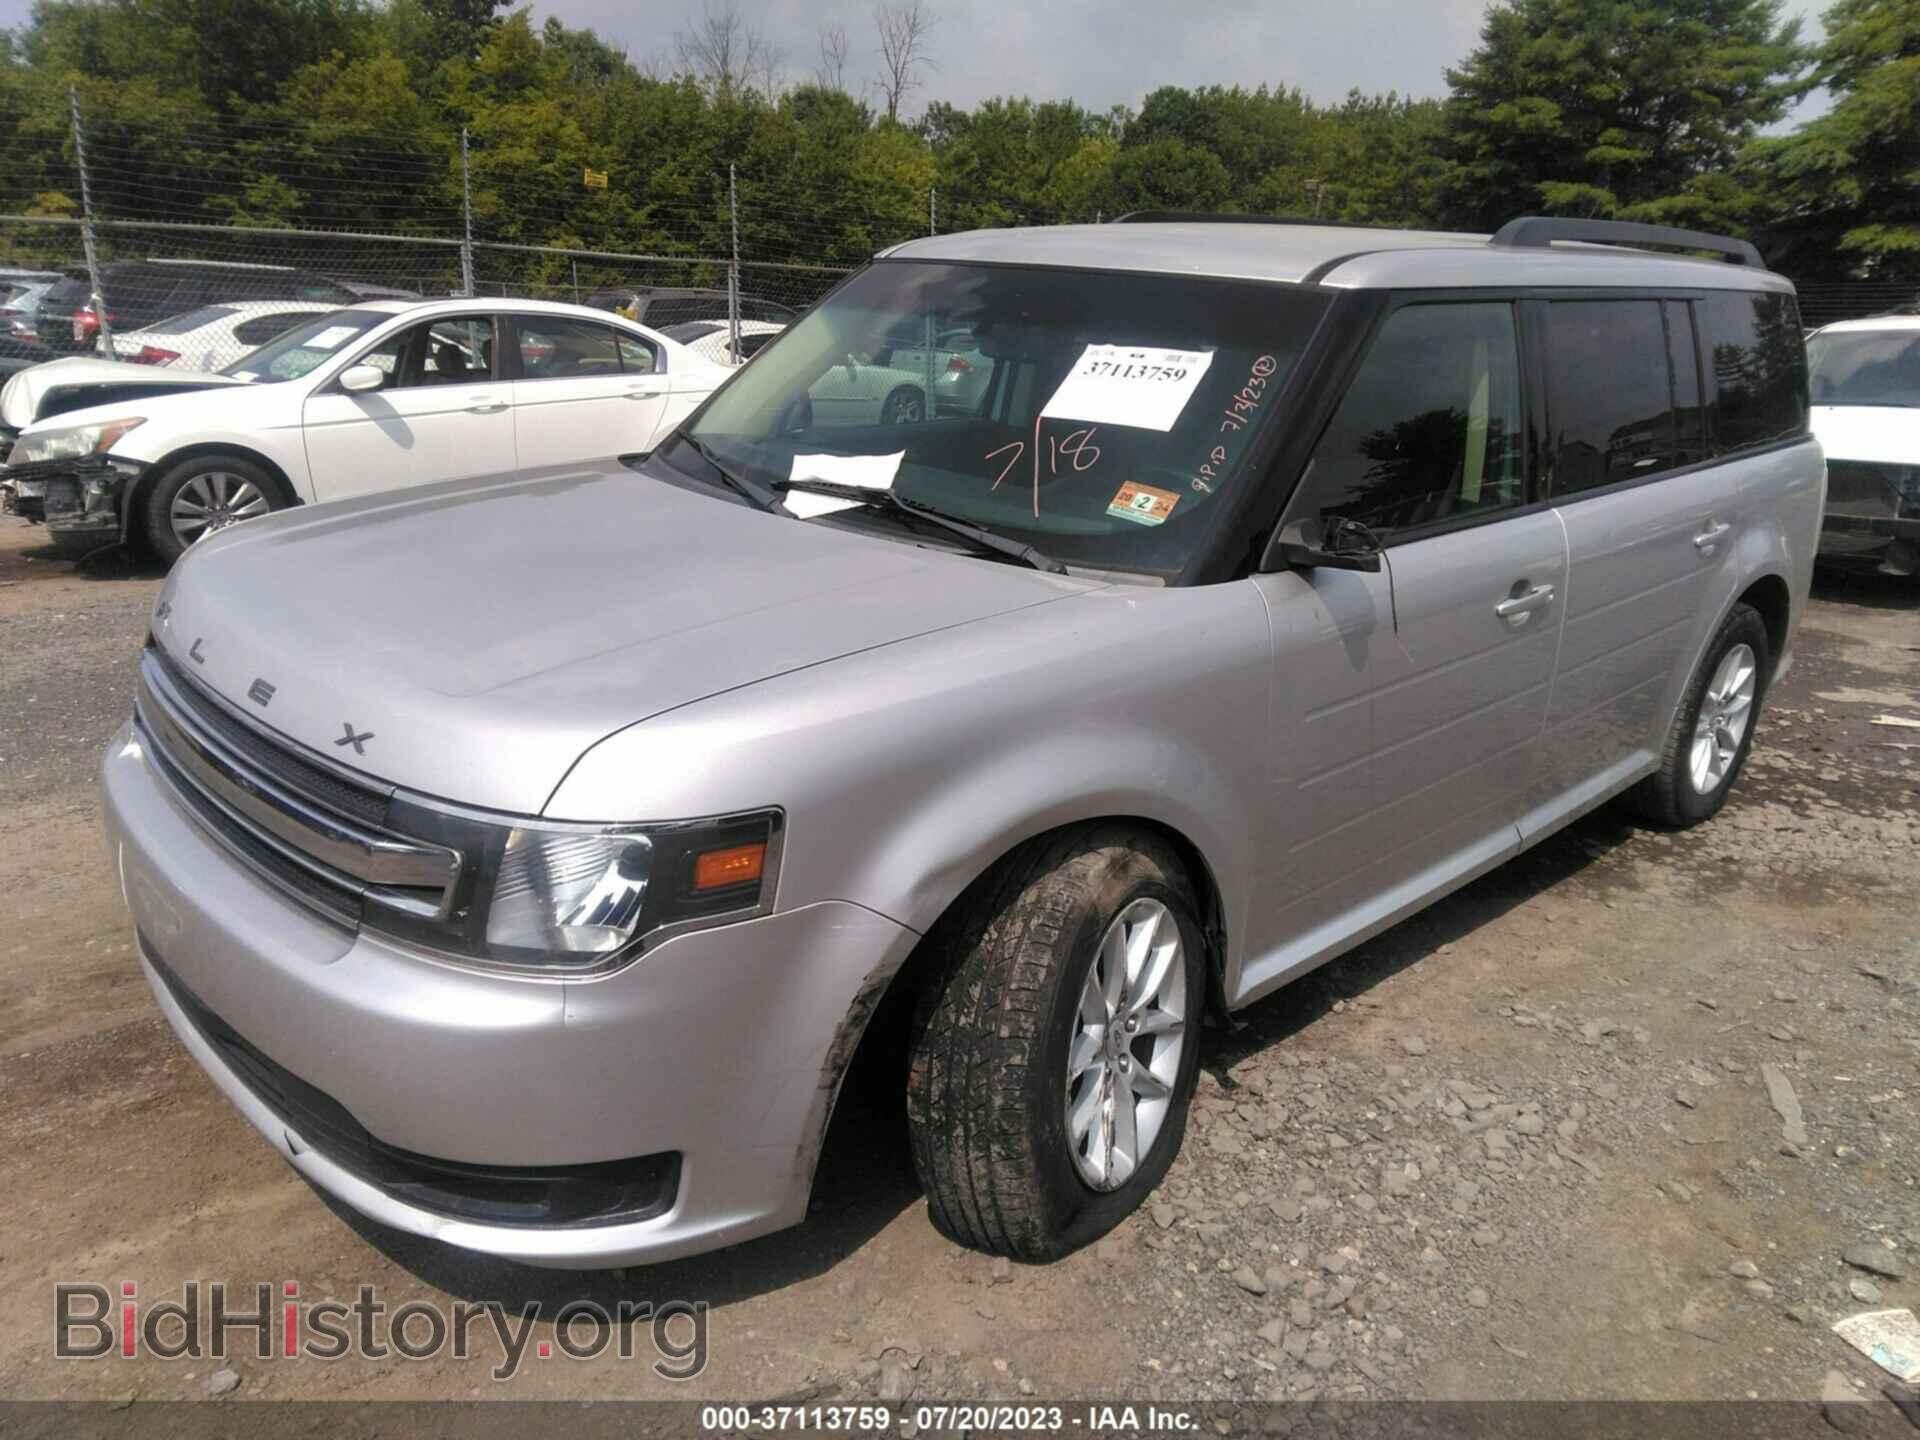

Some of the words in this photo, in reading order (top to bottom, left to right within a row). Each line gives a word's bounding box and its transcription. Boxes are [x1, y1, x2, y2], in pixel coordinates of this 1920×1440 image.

[1083, 361, 1187, 382] 37113759
[985, 416, 1100, 518] 7/18
[1137, 496, 1151, 509] 2
